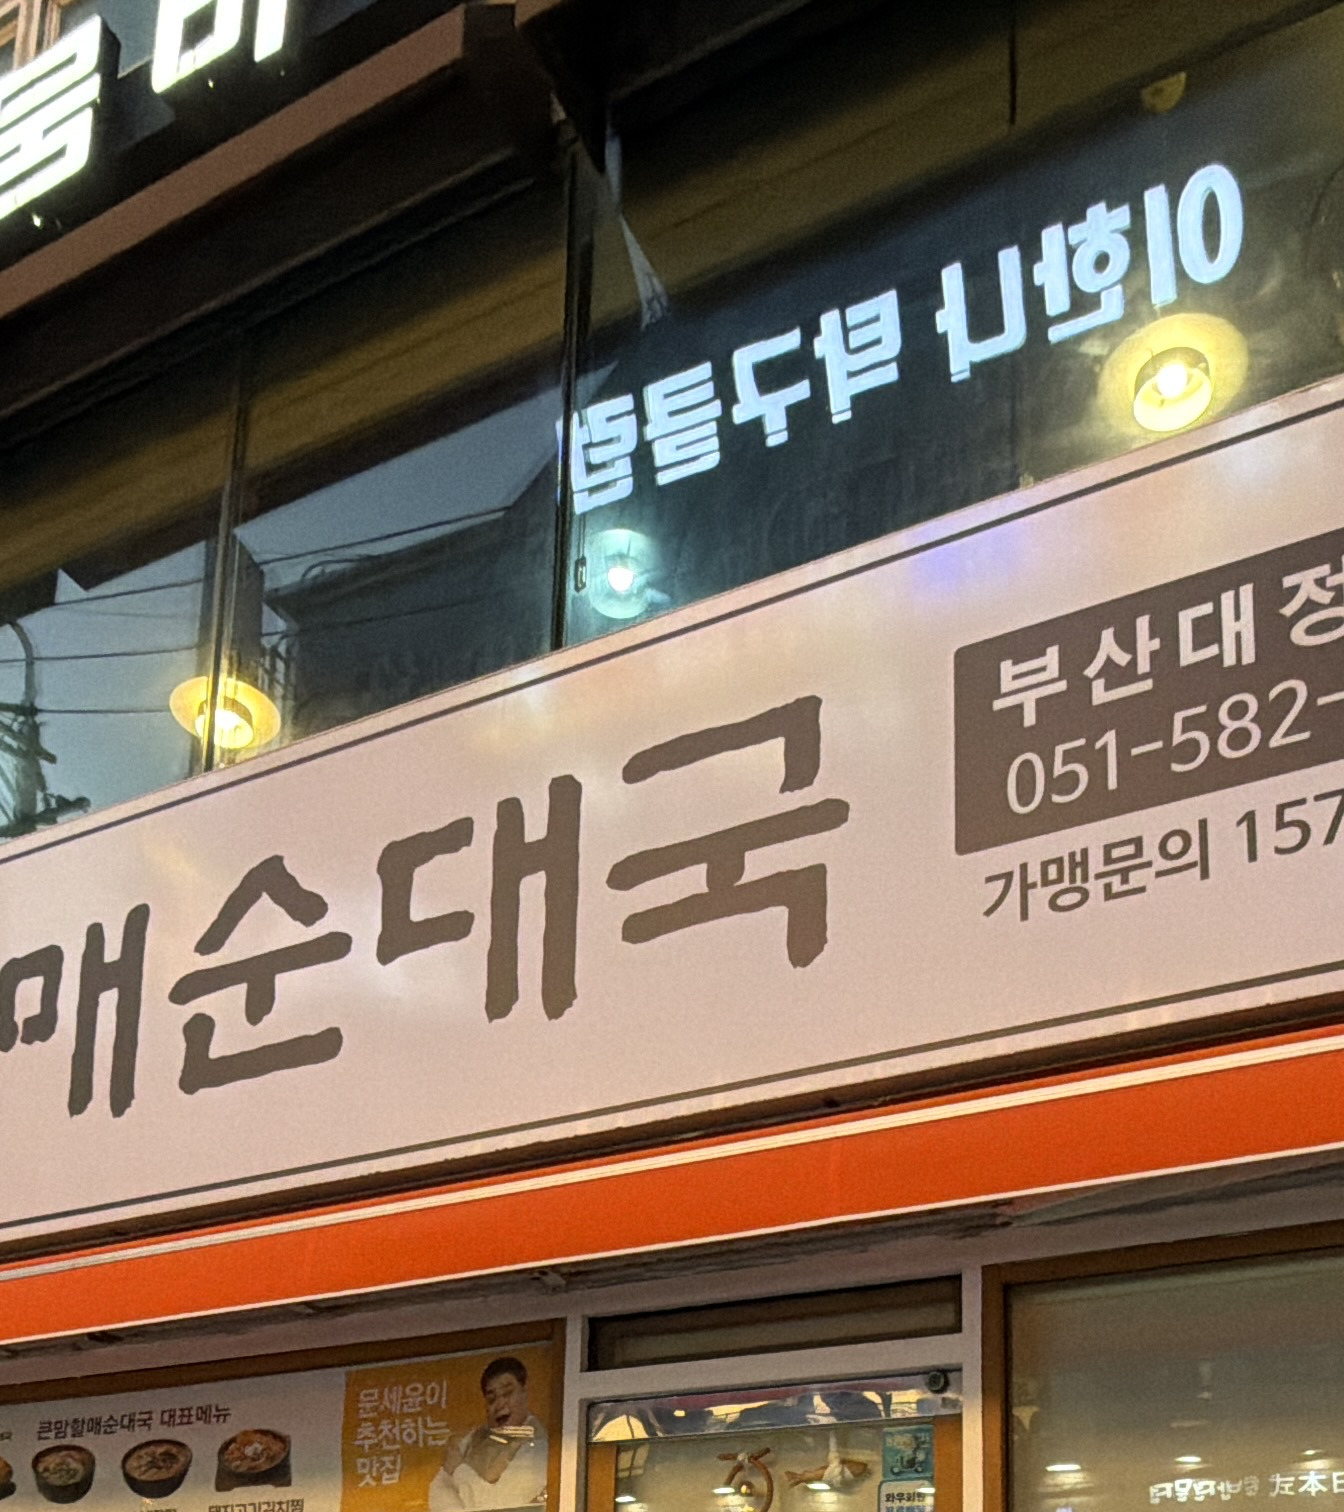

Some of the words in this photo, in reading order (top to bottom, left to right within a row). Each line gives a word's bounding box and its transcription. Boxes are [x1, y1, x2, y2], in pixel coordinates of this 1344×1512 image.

[981, 818, 1211, 924] 가맹문의
[160, 1404, 232, 1427] 대표메뉴
[353, 1416, 451, 1453] 추천하는
[357, 1454, 402, 1488] 맛집
